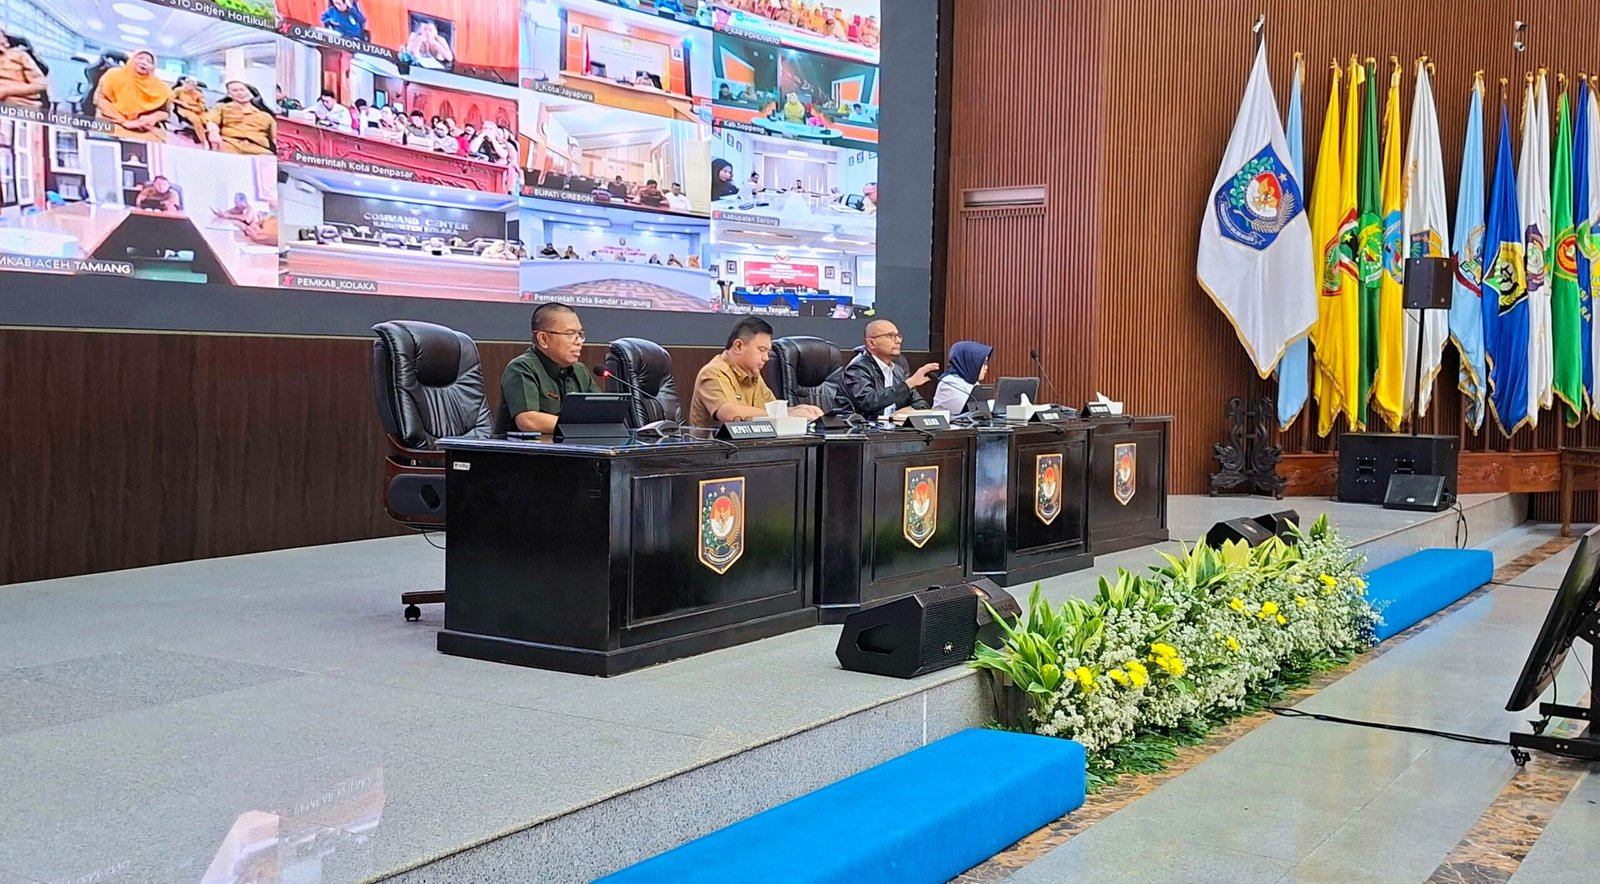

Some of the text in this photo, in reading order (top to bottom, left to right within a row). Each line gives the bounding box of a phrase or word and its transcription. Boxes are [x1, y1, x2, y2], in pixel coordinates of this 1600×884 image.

[294, 27, 392, 58] 0_KAB. BUTON UTARA
[562, 88, 593, 100] Jayapura
[48, 113, 111, 131] Indramayu
[296, 153, 414, 178] Pemerintah Kota Denpasar
[534, 188, 594, 202] BUPATI CIREBON
[722, 212, 756, 223] Kabupaten
[36, 258, 70, 270] ACEH
[73, 261, 131, 274] TAMIANG
[297, 277, 376, 291] PEMKAB_KOLAKA
[534, 293, 651, 308] Pemerintah Kota Bandar Lampung
